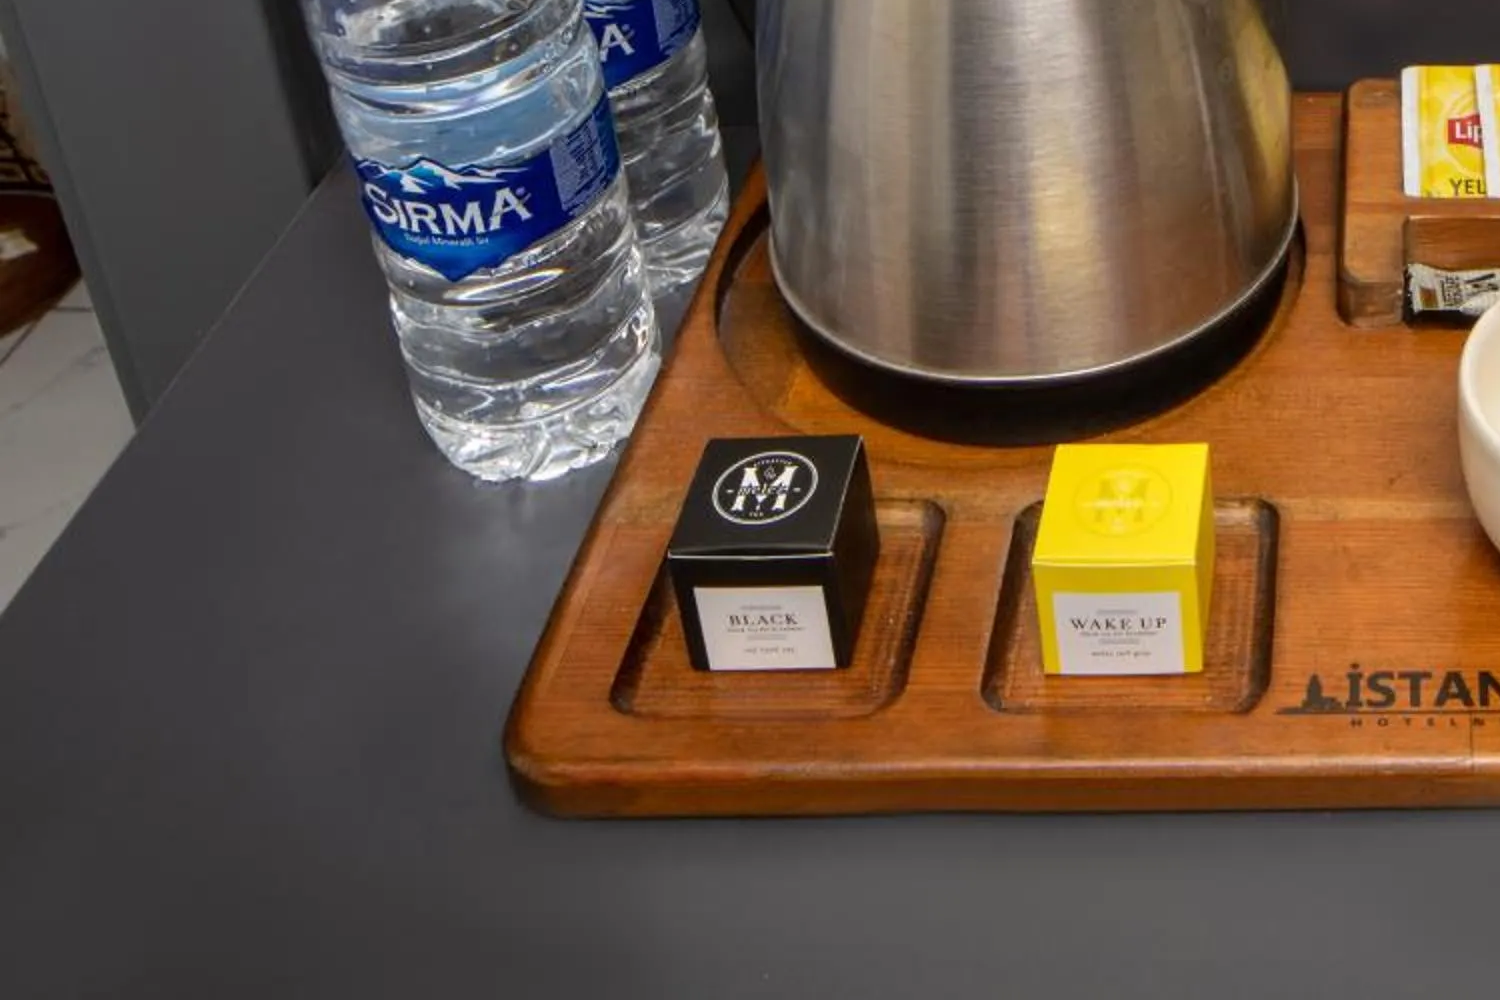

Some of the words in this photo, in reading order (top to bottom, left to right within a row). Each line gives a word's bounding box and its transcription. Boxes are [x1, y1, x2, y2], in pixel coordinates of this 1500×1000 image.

[727, 613, 799, 626] BLACK
[1070, 617, 1133, 630] WAKE
[1140, 616, 1167, 629] UP
